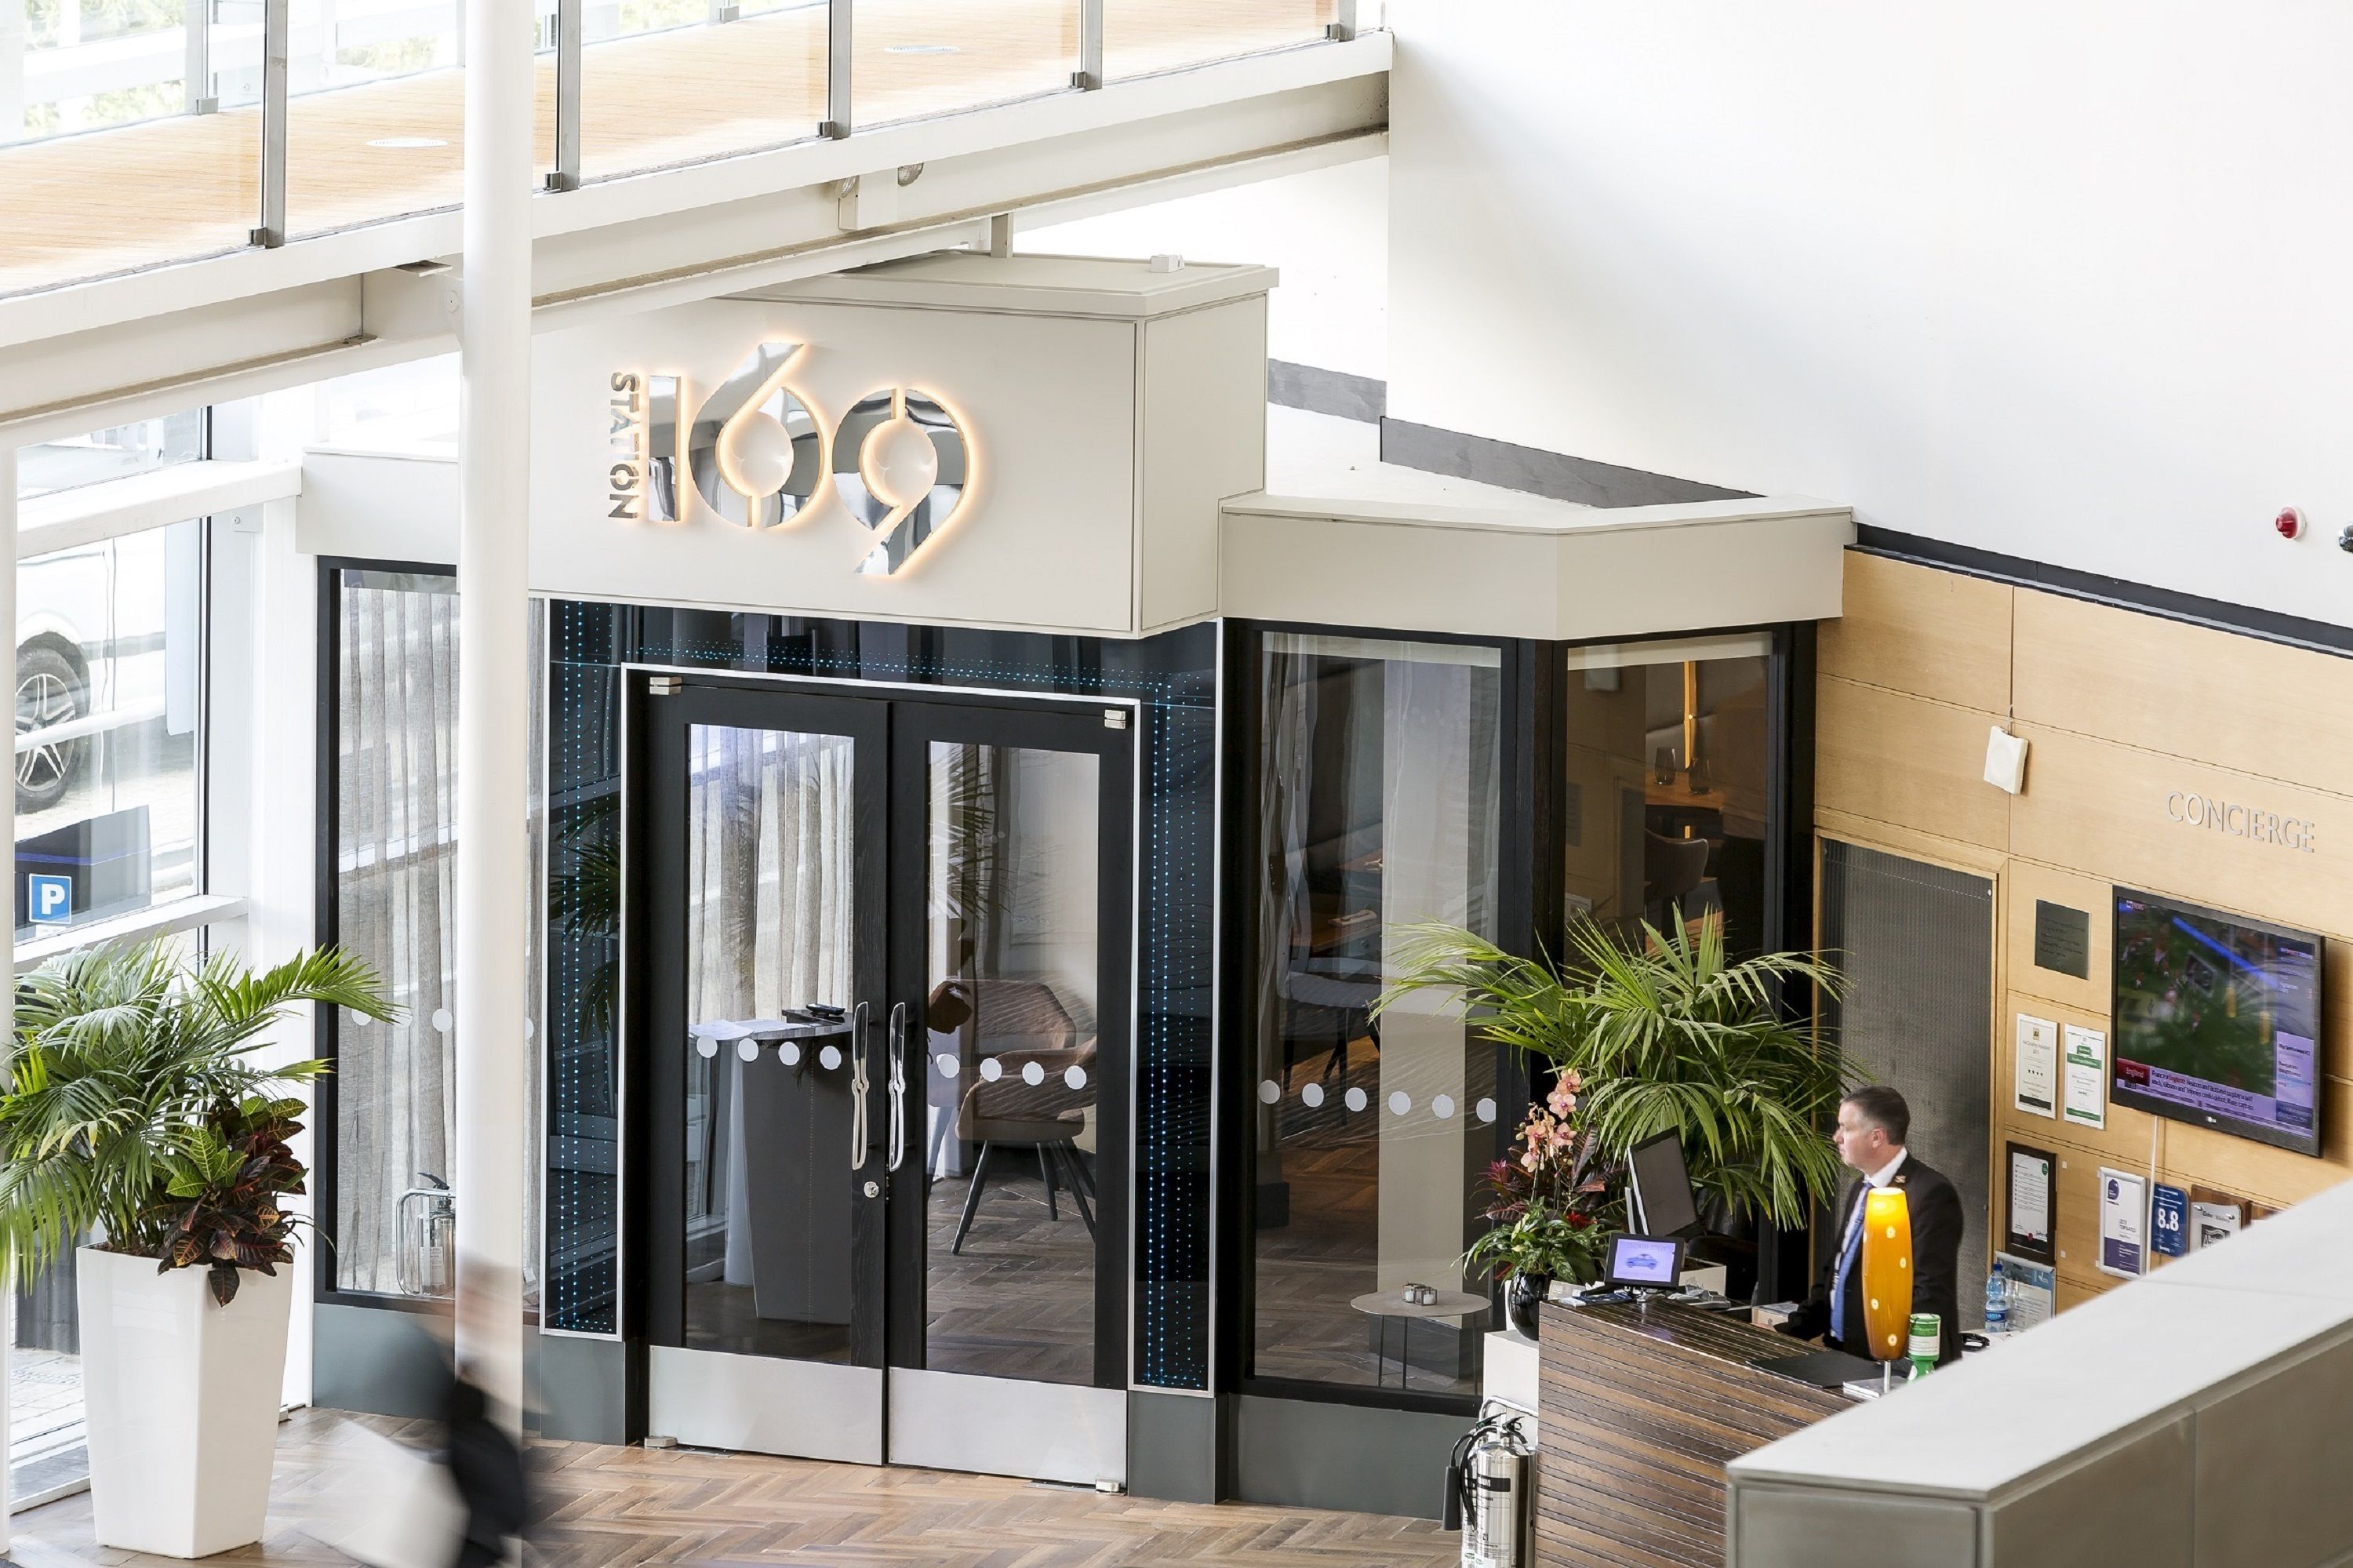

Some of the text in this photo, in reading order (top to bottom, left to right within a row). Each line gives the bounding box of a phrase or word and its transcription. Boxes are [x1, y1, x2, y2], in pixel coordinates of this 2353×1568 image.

[608, 372, 640, 519] STATION
[649, 343, 970, 575] 169
[2166, 791, 2315, 853] CONCIERGE
[42, 883, 65, 915] P
[2158, 1208, 2179, 1231] 8.8
